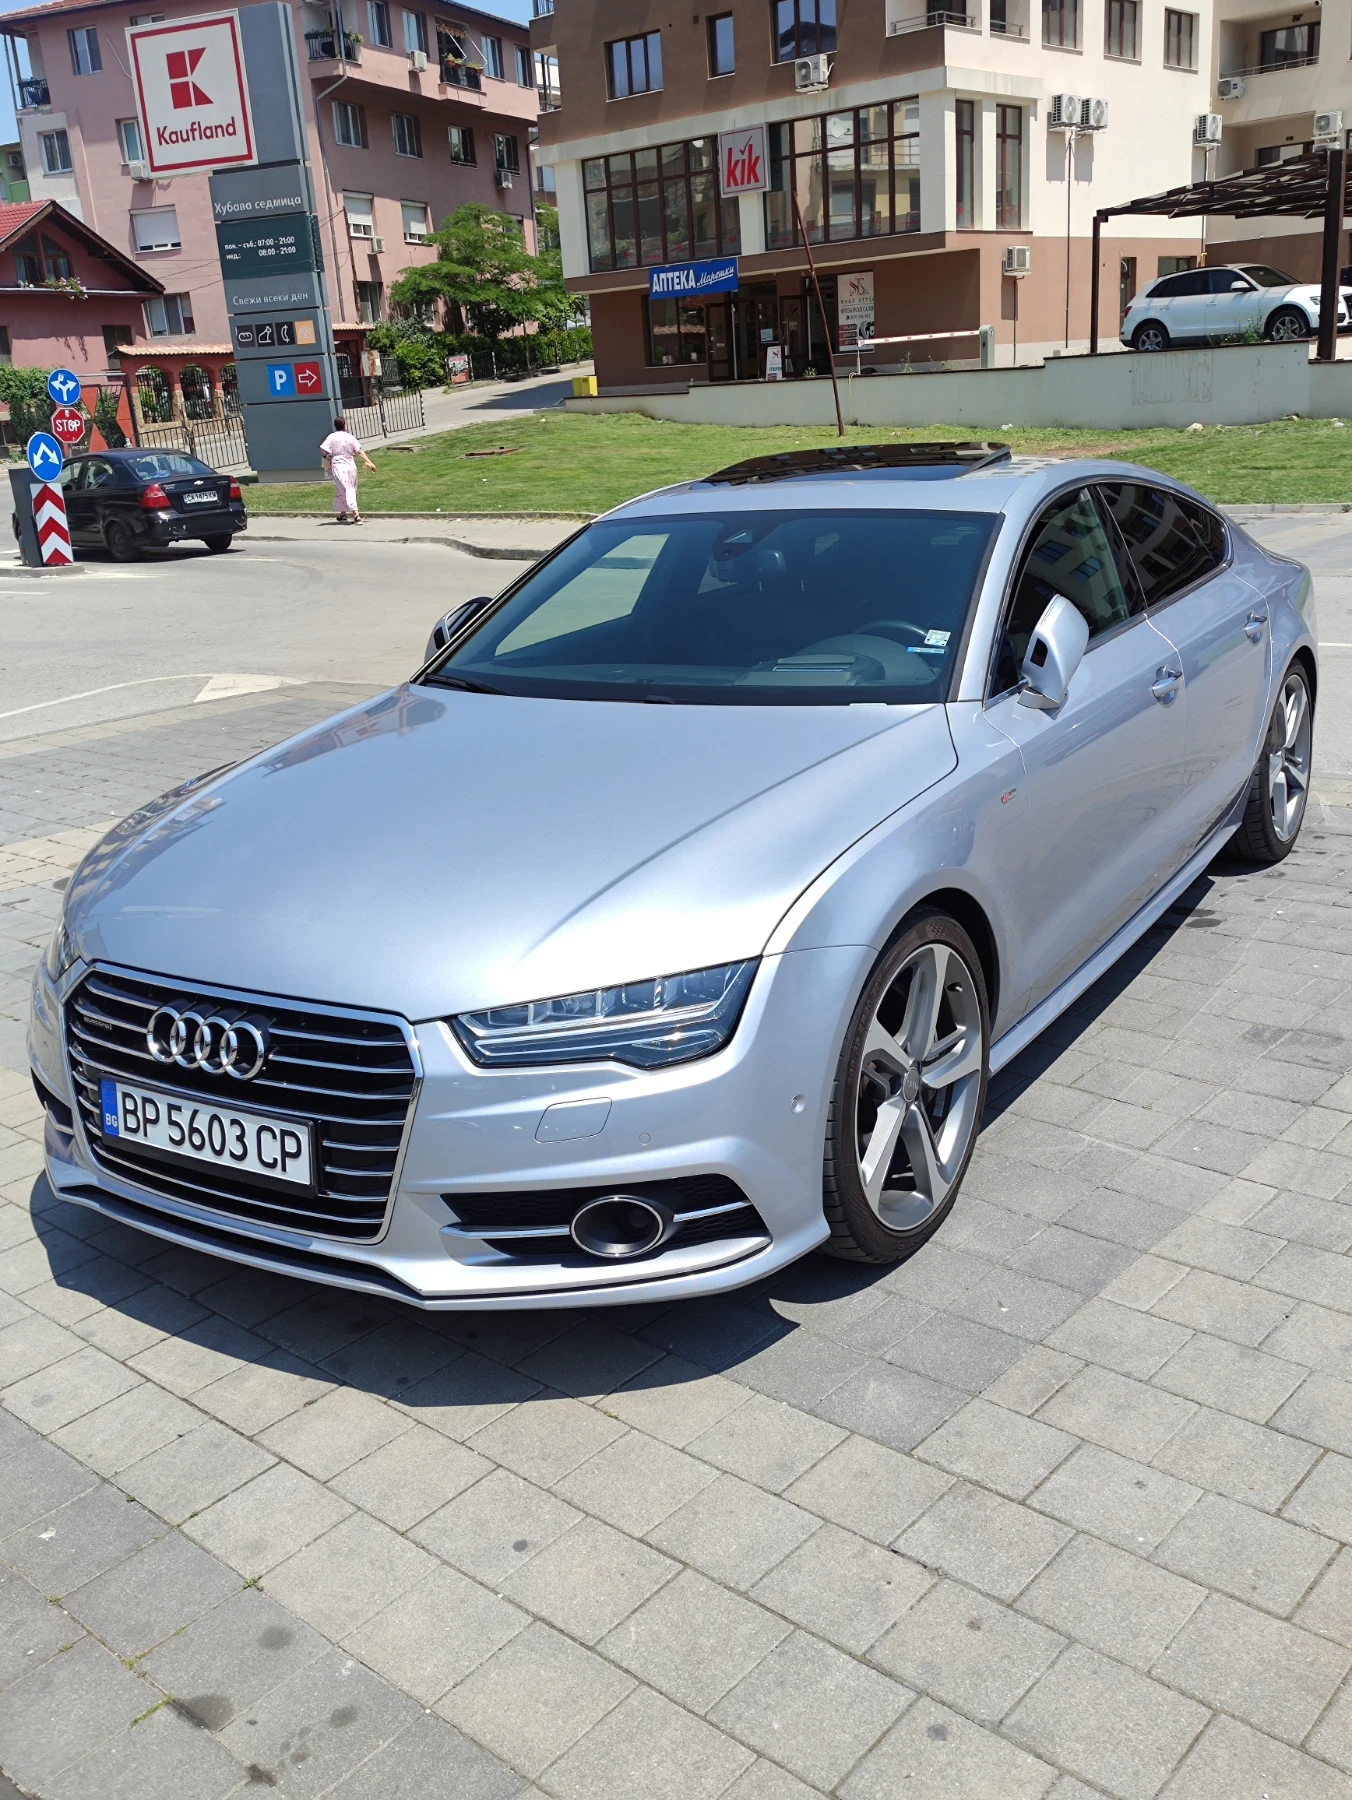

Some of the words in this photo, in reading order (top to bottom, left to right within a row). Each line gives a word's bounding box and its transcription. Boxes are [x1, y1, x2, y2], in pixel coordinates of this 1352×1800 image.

[156, 116, 237, 146] Kaufland
[726, 138, 761, 188] kik
[214, 201, 252, 216] Хубава
[254, 196, 301, 210] седмица
[257, 238, 275, 247] 07:00
[278, 236, 295, 245] 21:00
[258, 247, 276, 257] 08:00
[280, 246, 296, 255] 21:00
[652, 269, 696, 293] АПТЕКА
[697, 266, 735, 286] Марешки
[232, 295, 262, 306] Свежи
[263, 294, 289, 303] всеки
[291, 292, 309, 302] ден
[274, 370, 287, 390] P
[55, 419, 81, 432] STOP
[106, 1112, 118, 1128] BG
[121, 1091, 160, 1137] BP
[167, 1102, 249, 1162] 5603
[256, 1125, 302, 1173] CP
